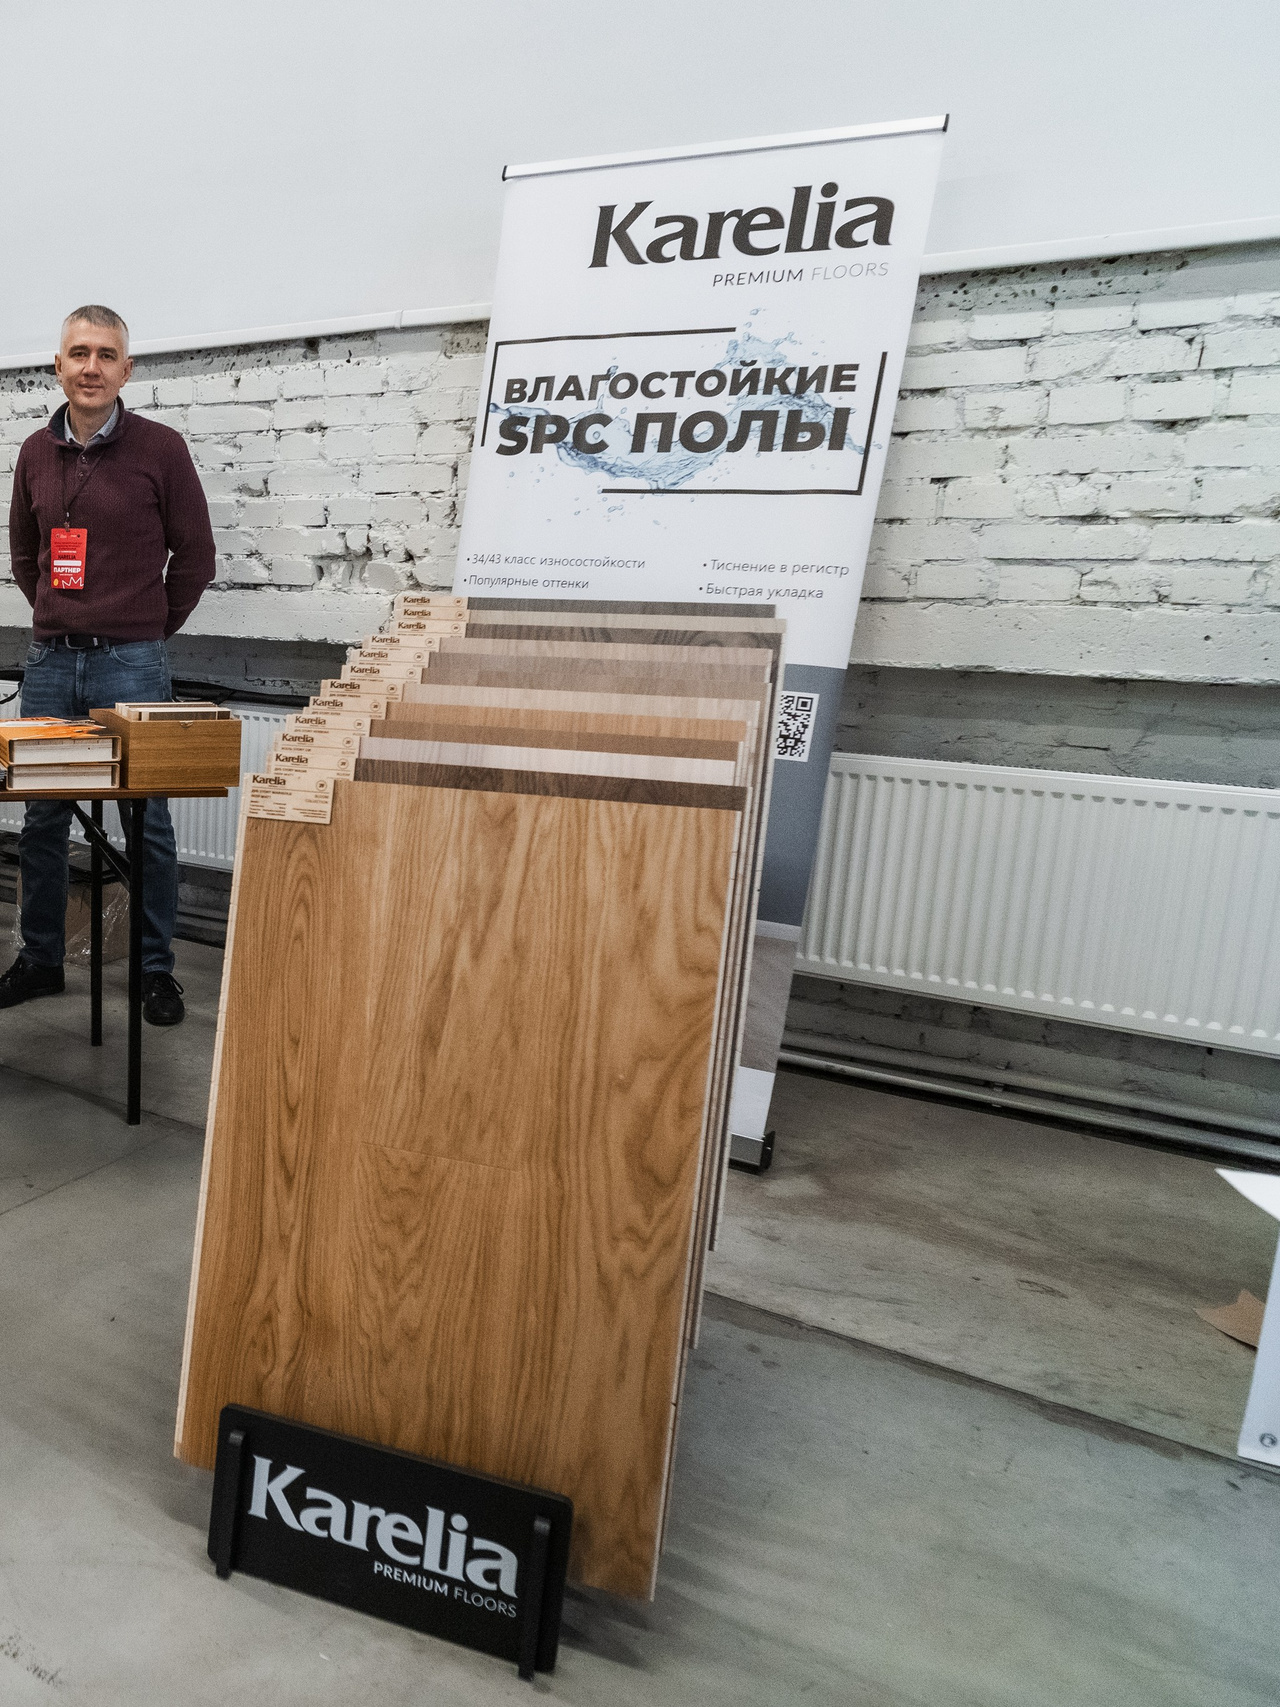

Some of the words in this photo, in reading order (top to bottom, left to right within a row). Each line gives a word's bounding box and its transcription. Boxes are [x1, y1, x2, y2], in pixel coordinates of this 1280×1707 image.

[588, 181, 895, 268] Karelia
[712, 268, 804, 287] PREMIUM
[810, 262, 889, 281] FLOORS
[503, 360, 859, 404] ВЛАГОСТОЙКИЕ
[495, 413, 613, 456] SPC
[631, 407, 851, 453] ПОЛЫ
[472, 554, 502, 565] 34/43
[505, 555, 536, 565] класс
[539, 556, 646, 569] износостойкости
[710, 559, 776, 573] Тиснение
[780, 565, 788, 573] в
[791, 565, 850, 578] регистр
[468, 575, 539, 588] Популярные
[542, 578, 589, 589] оттенки
[706, 583, 764, 598] Быстрая
[766, 588, 824, 600] укладка
[350, 666, 380, 674] Karelia
[330, 681, 360, 690] Karelia
[312, 698, 343, 707] Karelia
[295, 715, 326, 725] Karelia
[282, 733, 314, 743] Karelia
[275, 753, 308, 764] Karelia
[252, 775, 286, 785] Karelia
[247, 1454, 518, 1599] Karelia
[373, 1560, 448, 1597] PREMIUM
[453, 1587, 517, 1618] FLOORS
